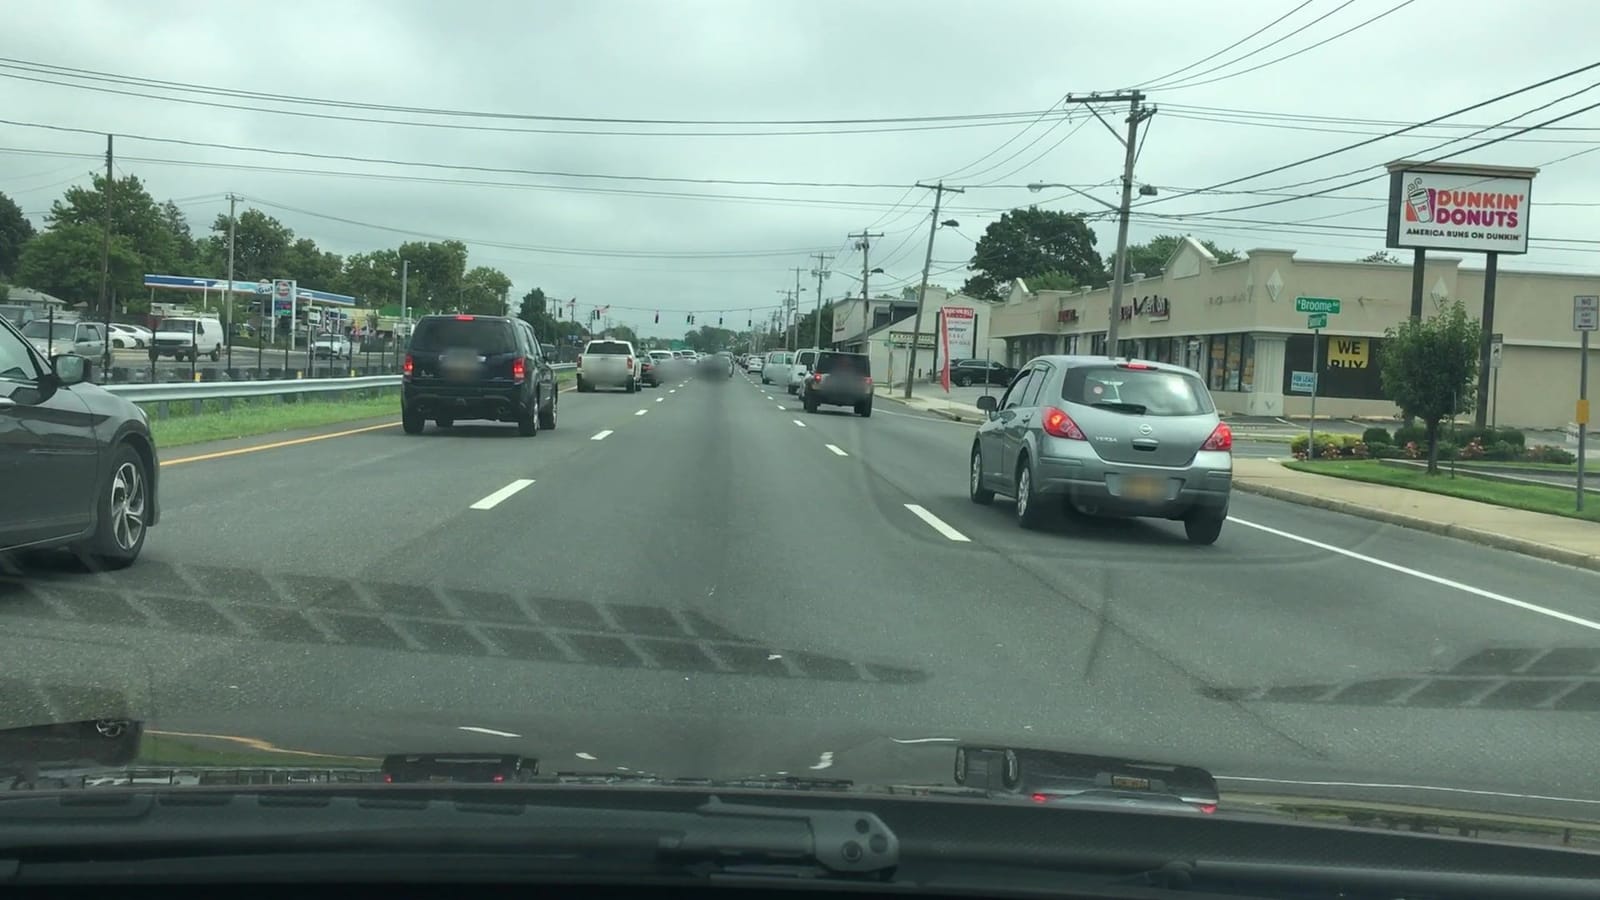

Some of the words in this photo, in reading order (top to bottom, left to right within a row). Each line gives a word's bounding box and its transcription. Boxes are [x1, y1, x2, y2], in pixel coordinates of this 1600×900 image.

[1437, 190, 1524, 210] DUNKIN'
[1436, 207, 1518, 228] DONUTS
[1406, 228, 1445, 237] AMERICA
[1446, 230, 1470, 239] RUNS
[1301, 299, 1332, 311] Broome
[1337, 340, 1361, 355] WE
